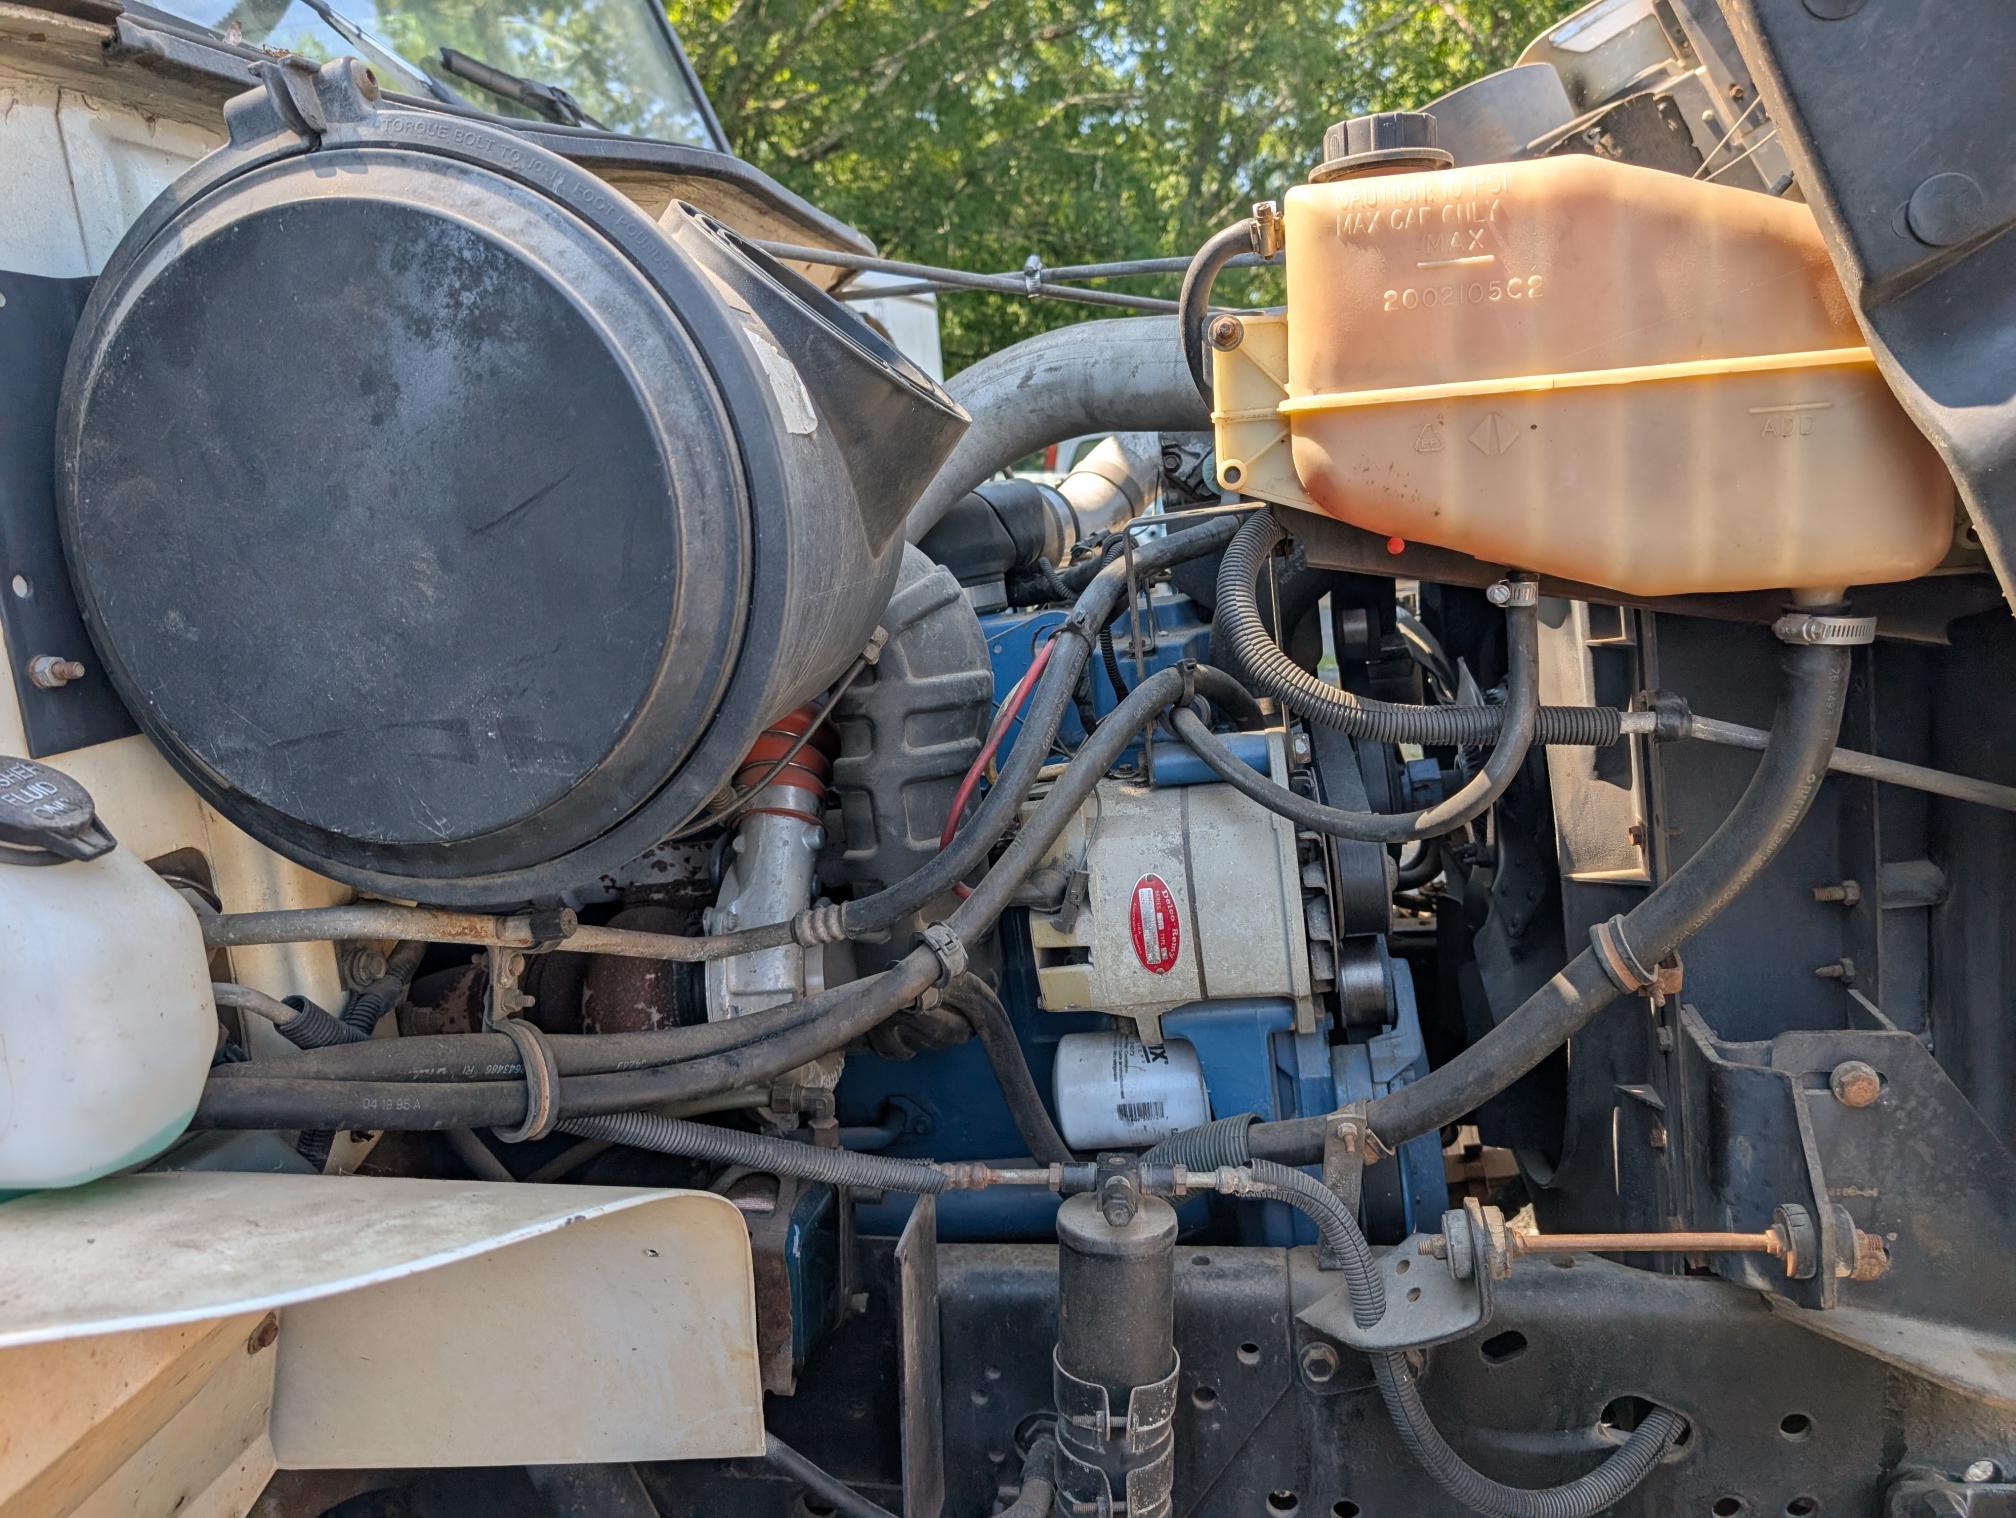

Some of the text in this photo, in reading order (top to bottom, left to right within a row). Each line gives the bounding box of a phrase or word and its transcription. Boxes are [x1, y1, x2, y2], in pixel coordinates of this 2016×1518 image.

[382, 118, 449, 140] TORQUE
[453, 129, 497, 154] BOLT
[500, 146, 523, 163] TO
[572, 182, 615, 217] FOOT
[616, 214, 673, 273] POUNDS
[1336, 210, 1381, 237] MAX
[1426, 228, 1484, 254] MAX
[1383, 274, 1544, 312] 2002105C2
[1761, 415, 1816, 438] ADD
[0, 762, 45, 788] SHER
[1, 780, 58, 807] FLUID
[362, 1097, 378, 1110] 04
[396, 1097, 411, 1111] 95
[413, 1097, 421, 1111] A
